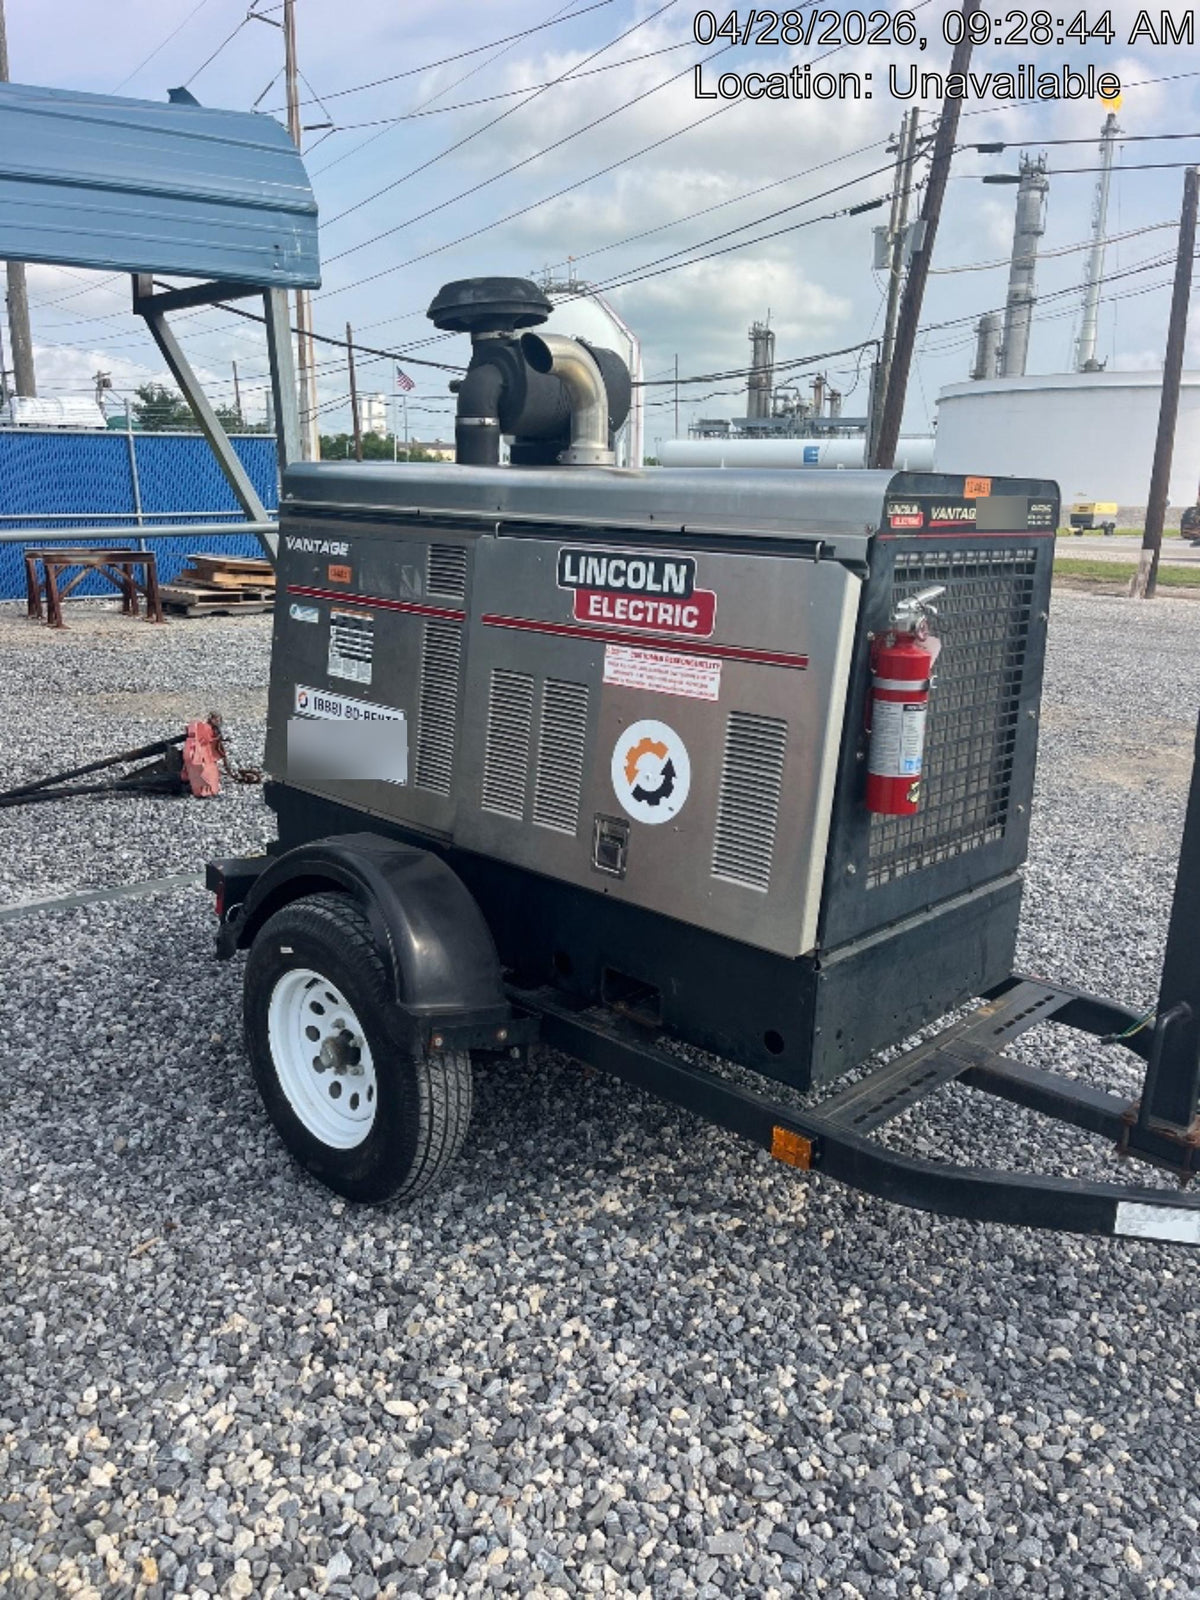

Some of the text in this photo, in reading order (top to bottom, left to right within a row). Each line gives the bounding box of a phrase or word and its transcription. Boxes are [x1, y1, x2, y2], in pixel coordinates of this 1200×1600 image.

[285, 535, 349, 556] VANTAGE
[564, 554, 687, 594] LINCOLN
[588, 595, 699, 628] ELECTRIC
